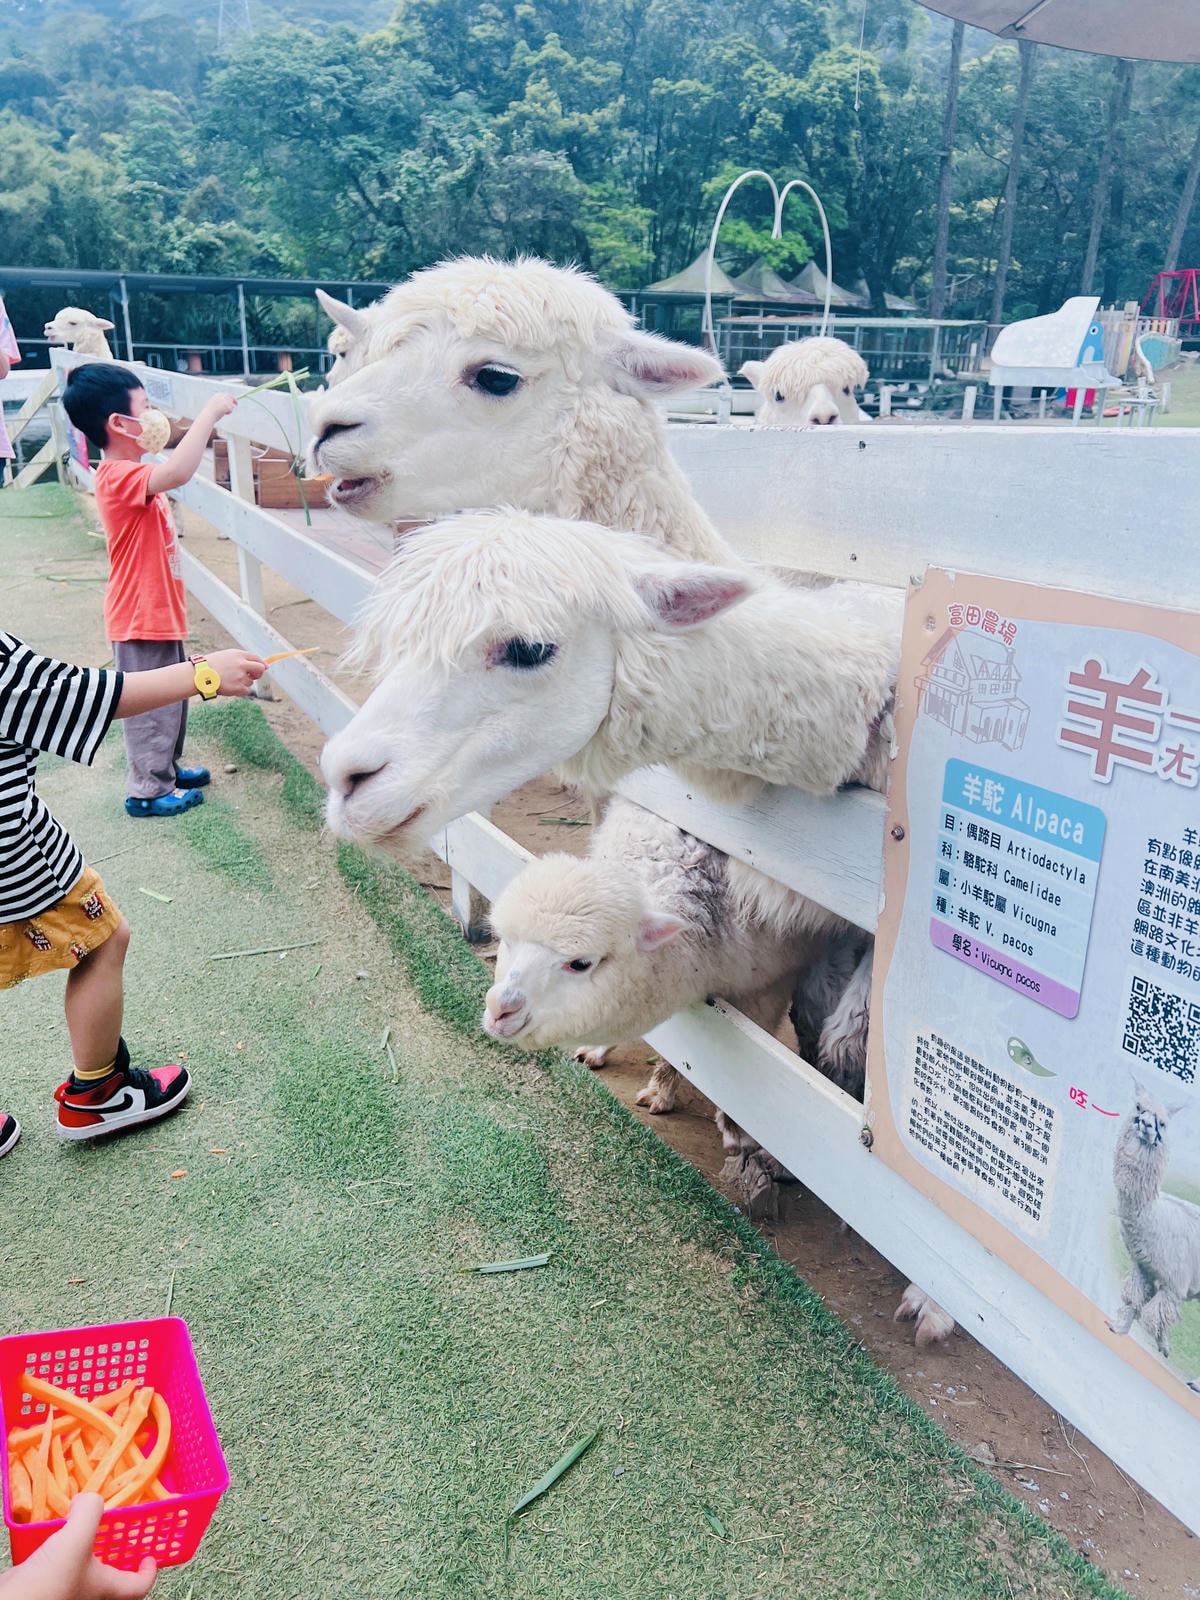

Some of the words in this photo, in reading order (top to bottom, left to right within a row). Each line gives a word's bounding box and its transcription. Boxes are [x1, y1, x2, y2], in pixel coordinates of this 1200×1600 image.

[947, 603, 1018, 646] 富田農場
[960, 773, 1005, 814] 羊駝
[1010, 792, 1084, 845] Alpaca
[1006, 840, 1086, 885] Artiodactyla
[1003, 869, 1062, 907] Camelidae
[985, 920, 995, 938] V.
[1002, 932, 1035, 957] pacos
[1013, 903, 1057, 937] Vicugna
[1133, 918, 1200, 957] 網路文化
[1016, 972, 1041, 993] pacos
